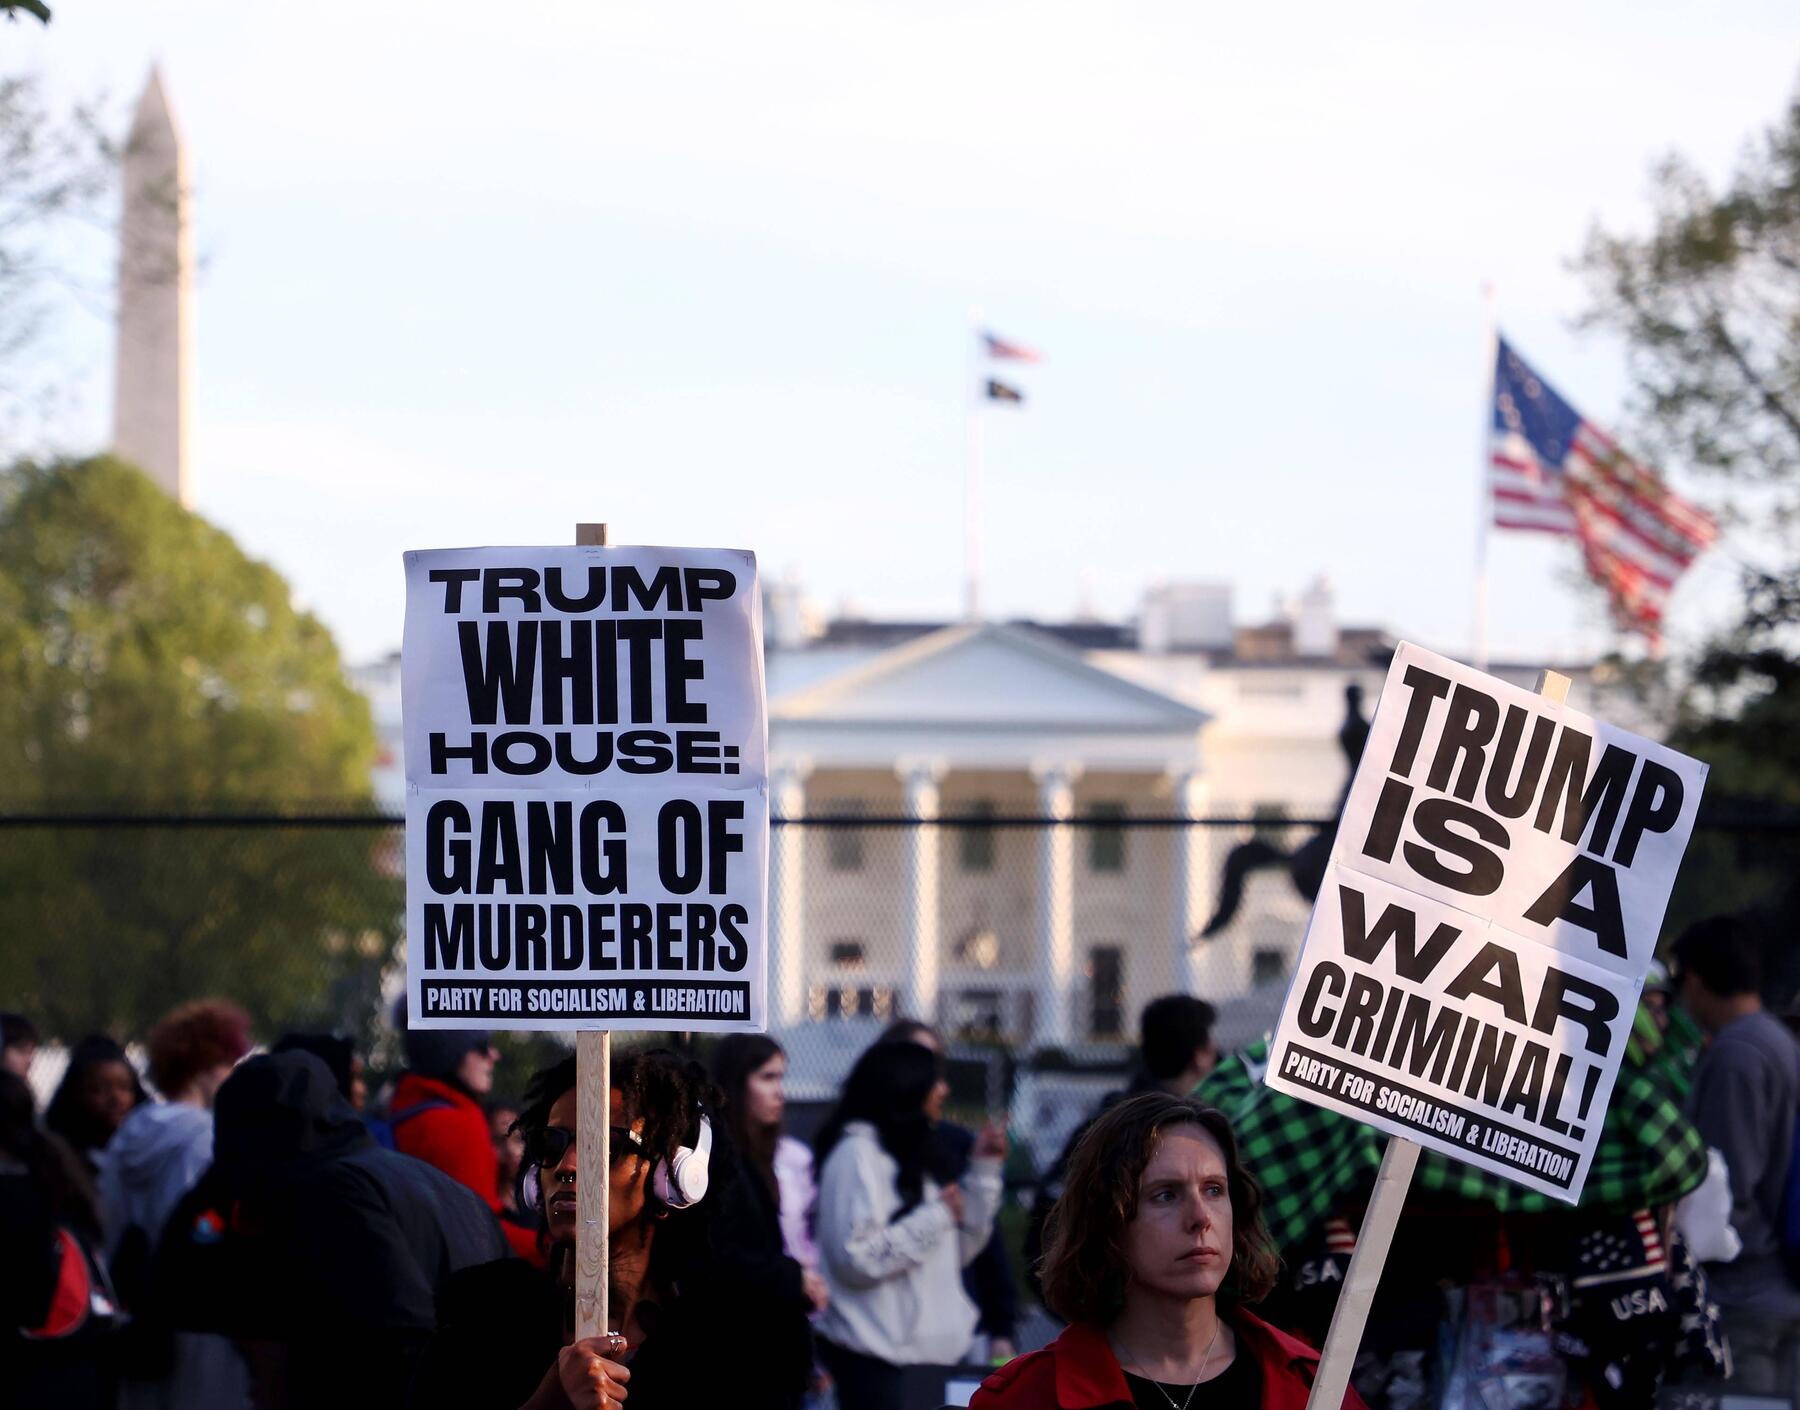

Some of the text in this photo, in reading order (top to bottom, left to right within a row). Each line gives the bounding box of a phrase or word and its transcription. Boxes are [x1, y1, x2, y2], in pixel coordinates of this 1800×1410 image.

[429, 566, 737, 614] TRUMP
[458, 619, 707, 726] WHITE
[429, 730, 740, 776] HOUSE:
[1389, 664, 1685, 869] TRUMP
[426, 799, 745, 896] GANG OF
[1361, 776, 1629, 961] IS A
[424, 903, 749, 972] MURDERERS
[1338, 884, 1620, 1059] WAR
[427, 987, 744, 1013] PARTY FOR SOCIALISM & LIBERATION
[1297, 960, 1603, 1143] CRIMINAL!
[1284, 1050, 1574, 1182] PARTY FOR SOCIALISM & LIBERATION
[1610, 1286, 1668, 1321] USA
